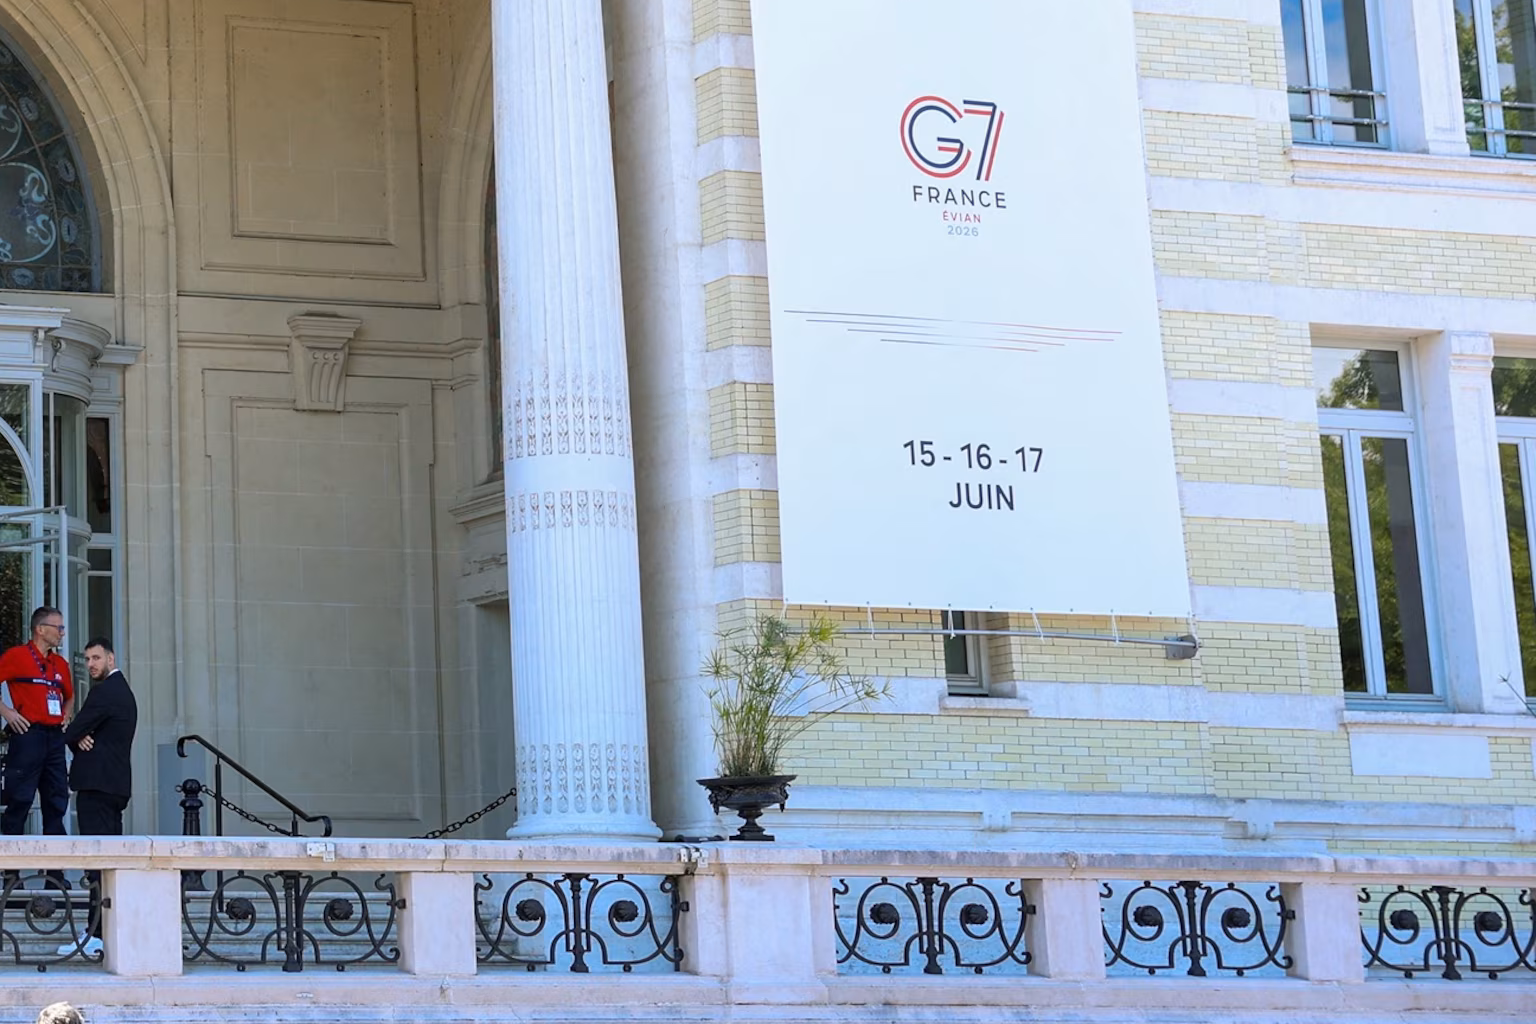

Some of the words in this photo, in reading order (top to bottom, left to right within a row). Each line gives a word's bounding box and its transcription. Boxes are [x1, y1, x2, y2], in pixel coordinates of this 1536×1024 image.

[899, 95, 1005, 182] G7
[912, 184, 1007, 209] FRANCE
[942, 209, 981, 224] ÉVIAN
[947, 224, 979, 237] 2026
[948, 481, 1015, 512] JUIN
